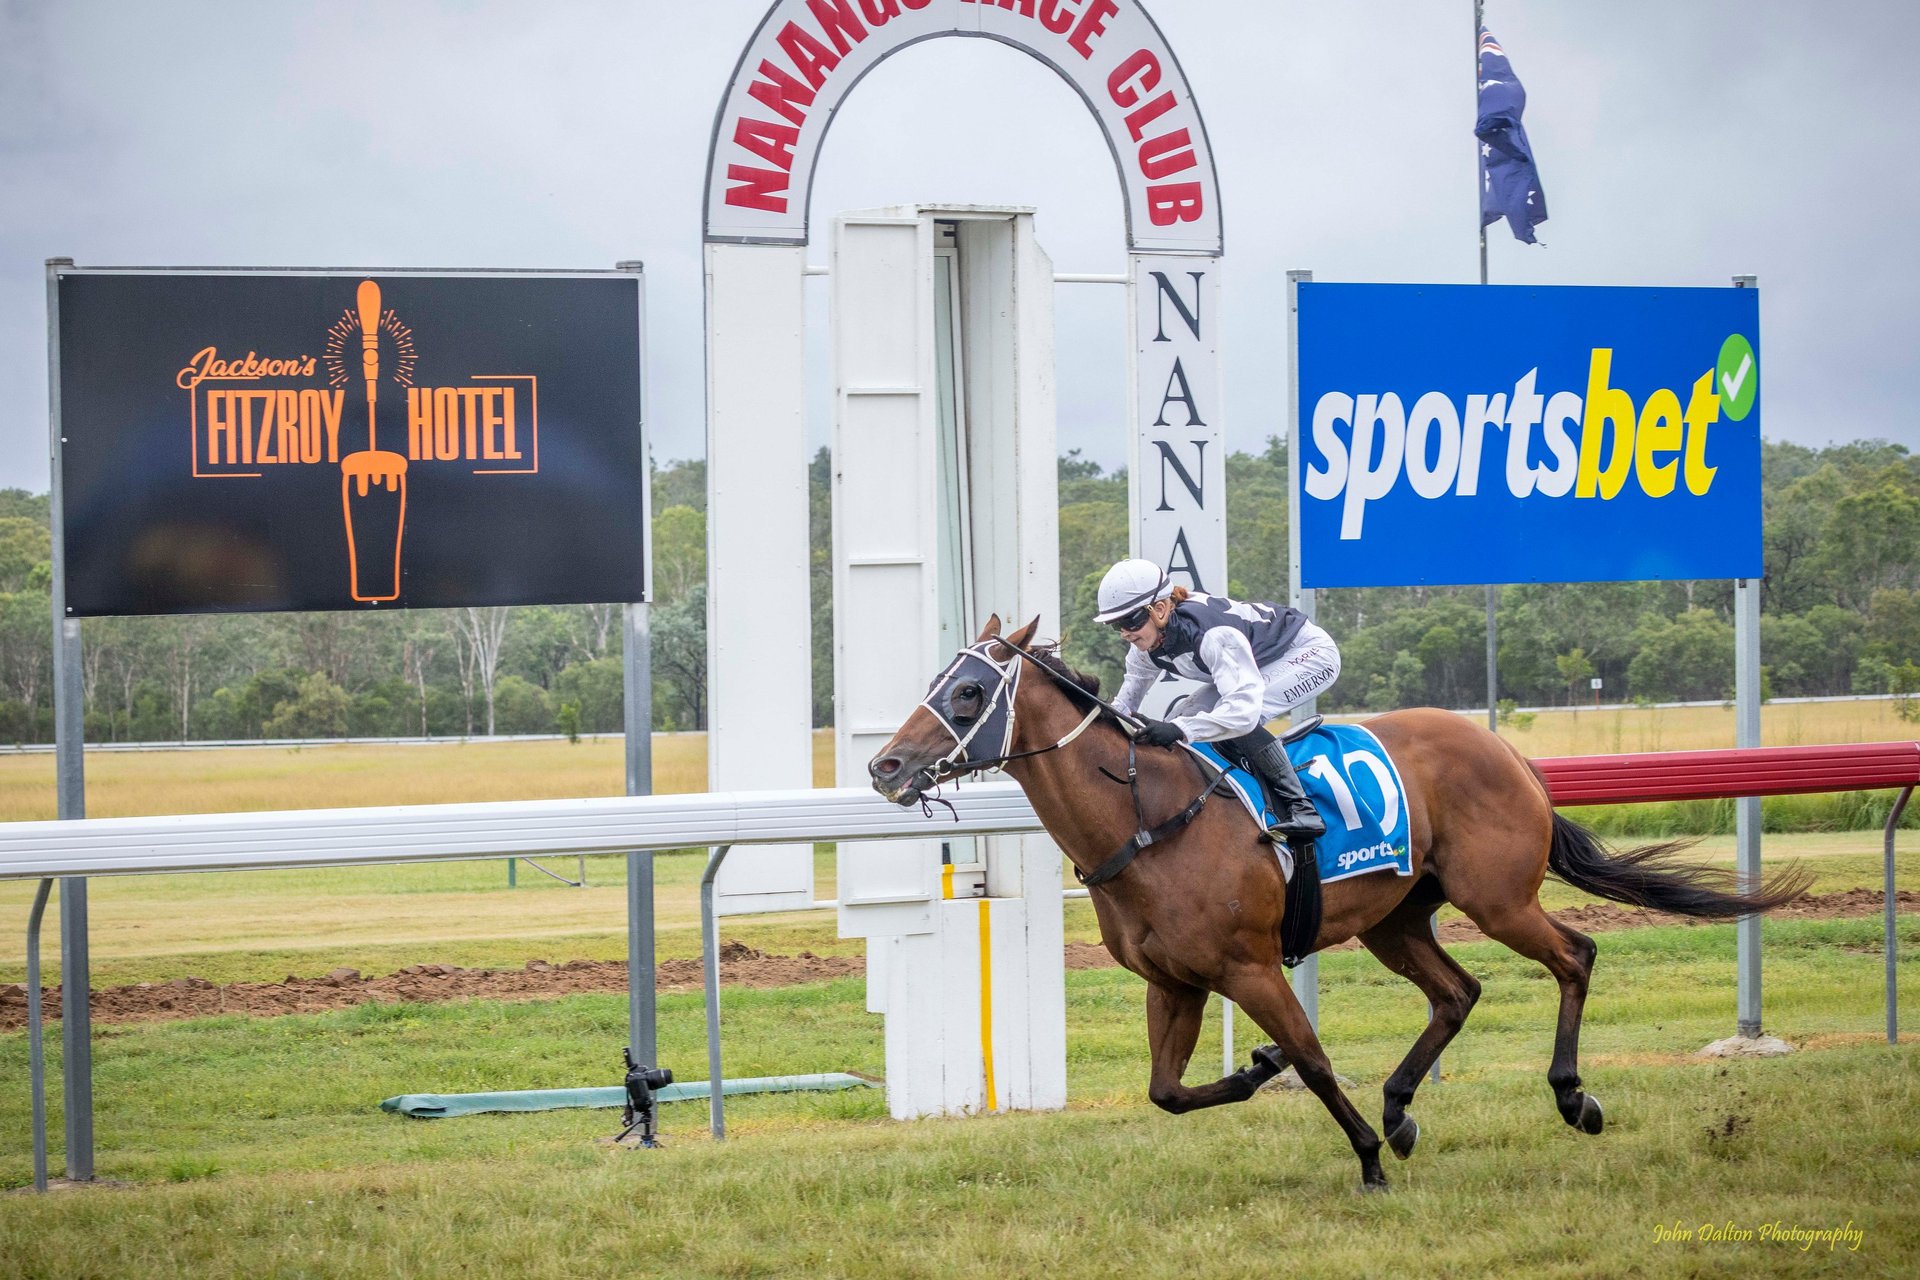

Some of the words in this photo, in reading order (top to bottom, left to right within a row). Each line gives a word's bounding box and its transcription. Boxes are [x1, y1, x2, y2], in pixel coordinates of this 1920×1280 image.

[725, 0, 932, 214] NANAN
[1107, 48, 1204, 227] CLUB
[176, 346, 318, 390] Jackson's
[206, 388, 346, 465] FITZROY
[407, 386, 522, 461] HOTEL
[1304, 348, 1722, 540] sportsbet
[1148, 271, 1213, 723] NANA
[1283, 664, 1335, 703] EMMERSON
[1307, 749, 1399, 837] 10
[1337, 840, 1398, 870] sports
